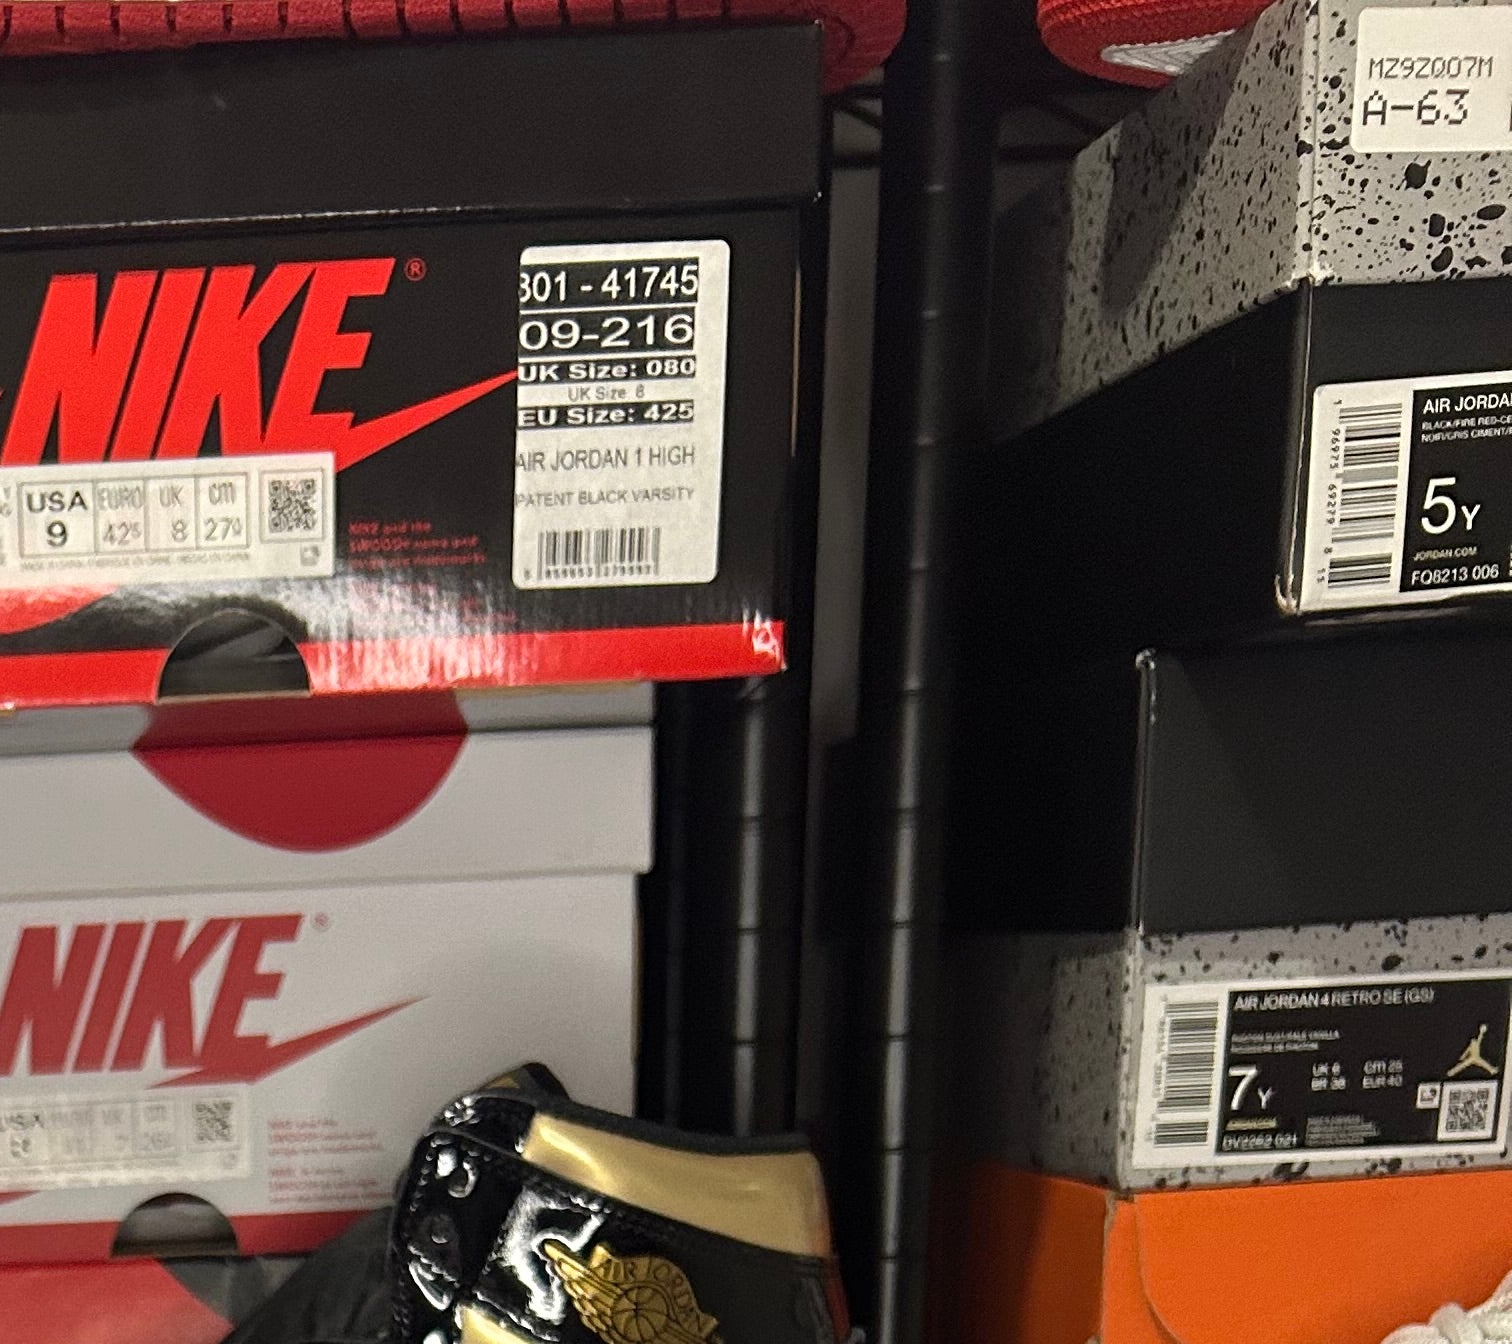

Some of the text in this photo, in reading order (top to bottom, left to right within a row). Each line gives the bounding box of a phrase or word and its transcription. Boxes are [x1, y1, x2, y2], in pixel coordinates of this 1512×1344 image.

[1362, 89, 1469, 125] A-63
[601, 265, 699, 299] 41745
[518, 314, 694, 350] 09-216
[0, 257, 396, 467] NIKE
[518, 358, 696, 382] UK Size: 080
[567, 387, 590, 401] UK
[636, 385, 645, 398] 8
[1423, 392, 1512, 414] AIR JORDA
[518, 403, 694, 426] EU Size: 425
[516, 451, 545, 472] AIR
[550, 448, 628, 471] JORDAN
[648, 445, 696, 466] HIGH
[26, 490, 89, 513] USA
[96, 488, 143, 510] EURO
[158, 486, 183, 507] UK
[515, 486, 695, 508] PATENT BLACK VARSITY
[46, 520, 68, 548] 9
[171, 519, 189, 543] 8
[1472, 564, 1500, 580] 006
[1260, 991, 1319, 1010] JORDAN
